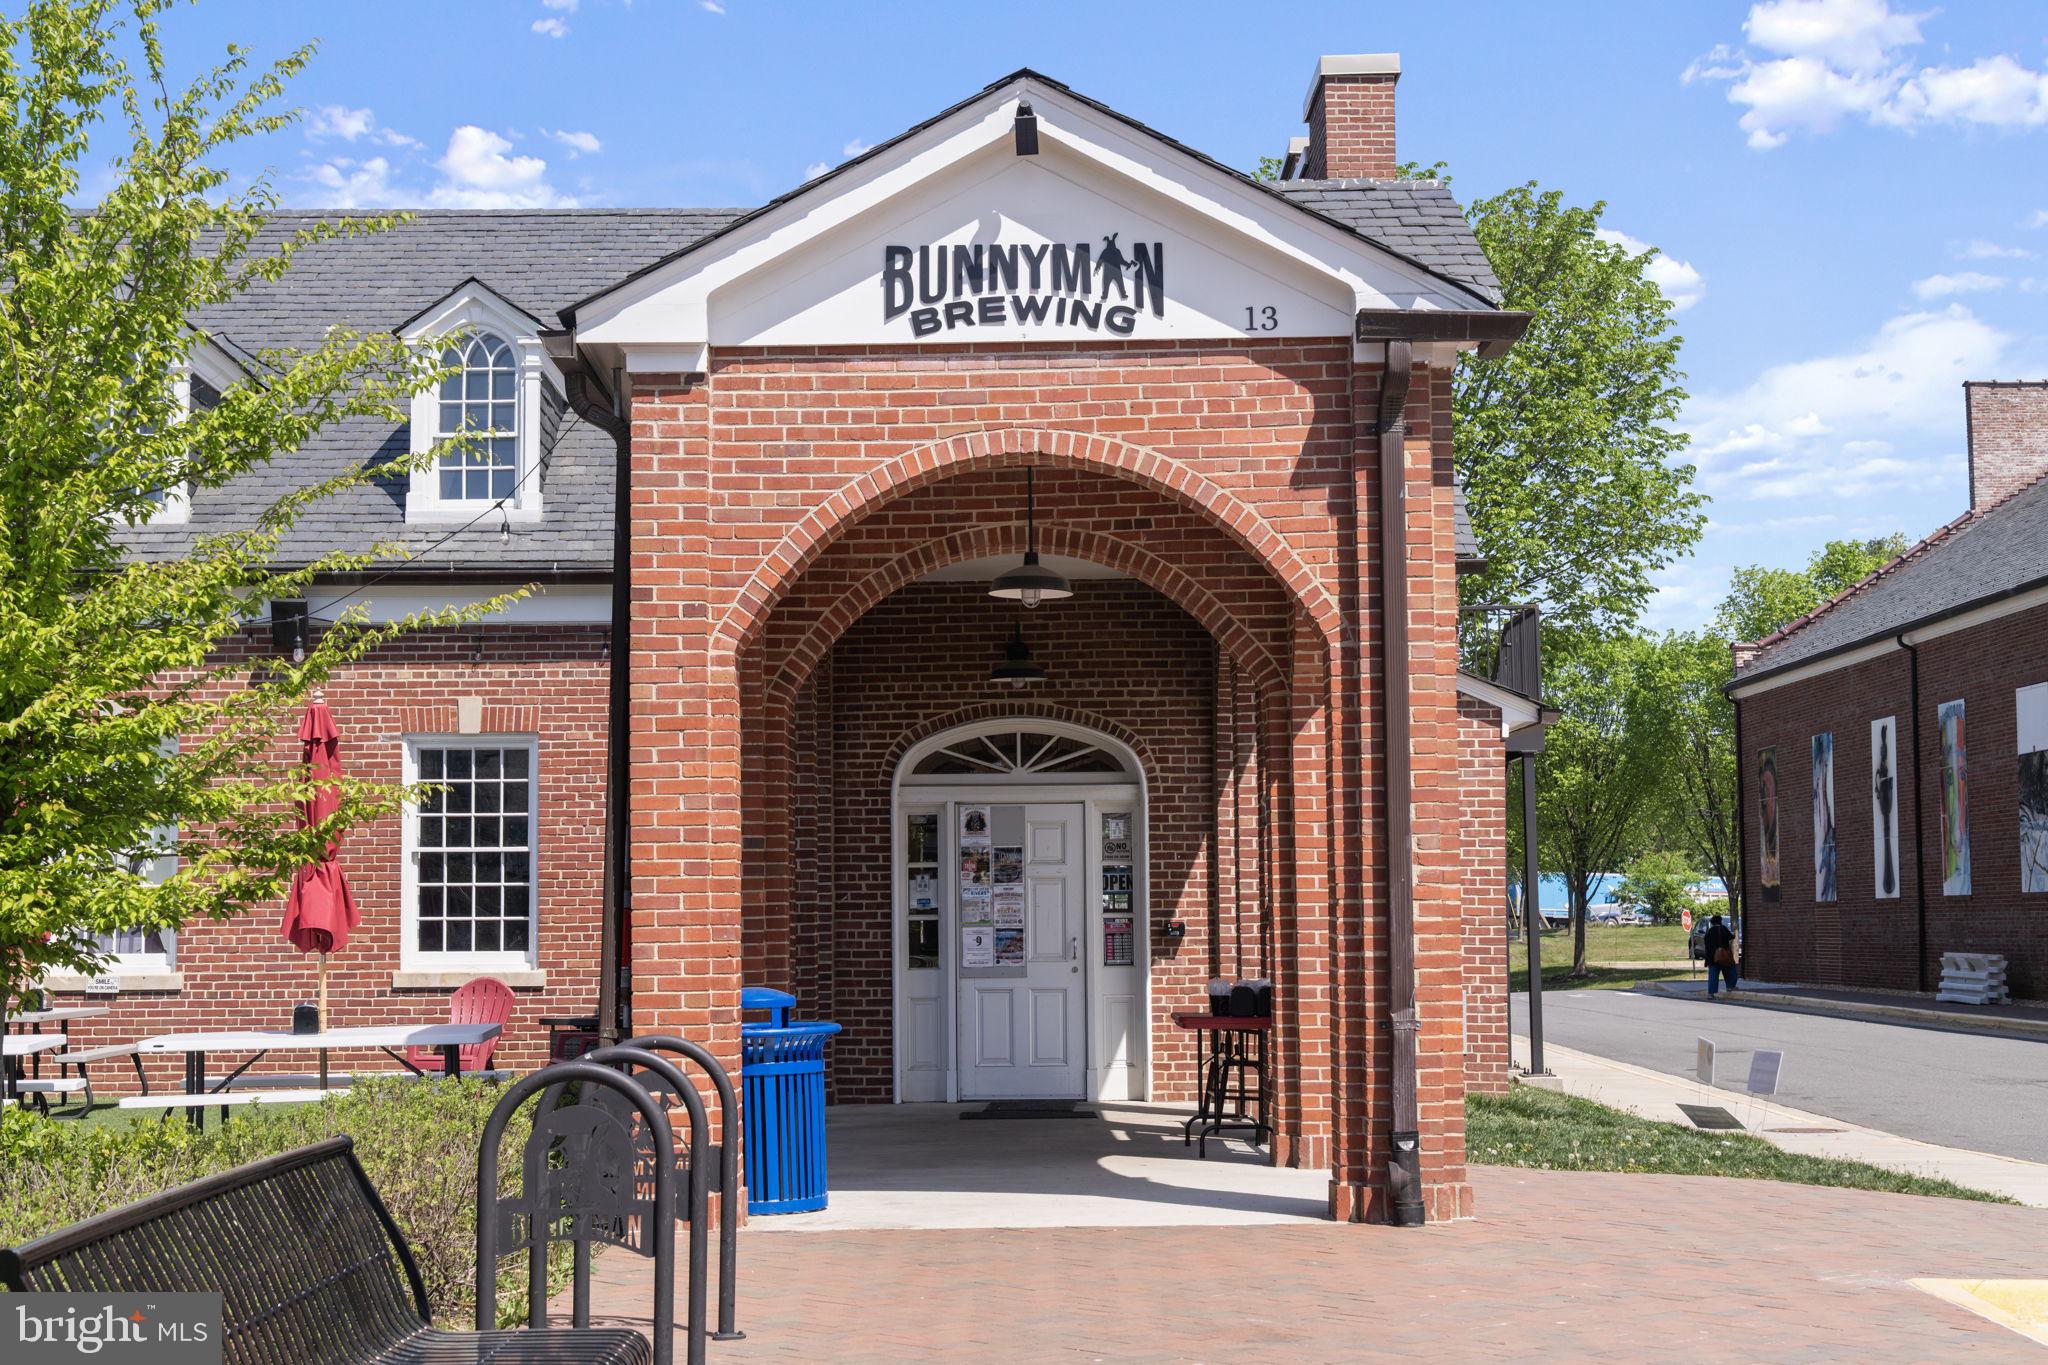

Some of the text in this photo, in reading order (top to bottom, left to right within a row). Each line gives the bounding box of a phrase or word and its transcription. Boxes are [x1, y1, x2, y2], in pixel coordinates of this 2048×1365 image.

[882, 236, 1164, 321] BUNNYMAN
[910, 294, 1138, 337] BREWING
[1244, 306, 1279, 332] 13
[1116, 842, 1127, 850] NO
[1103, 874, 1133, 891] OPEN
